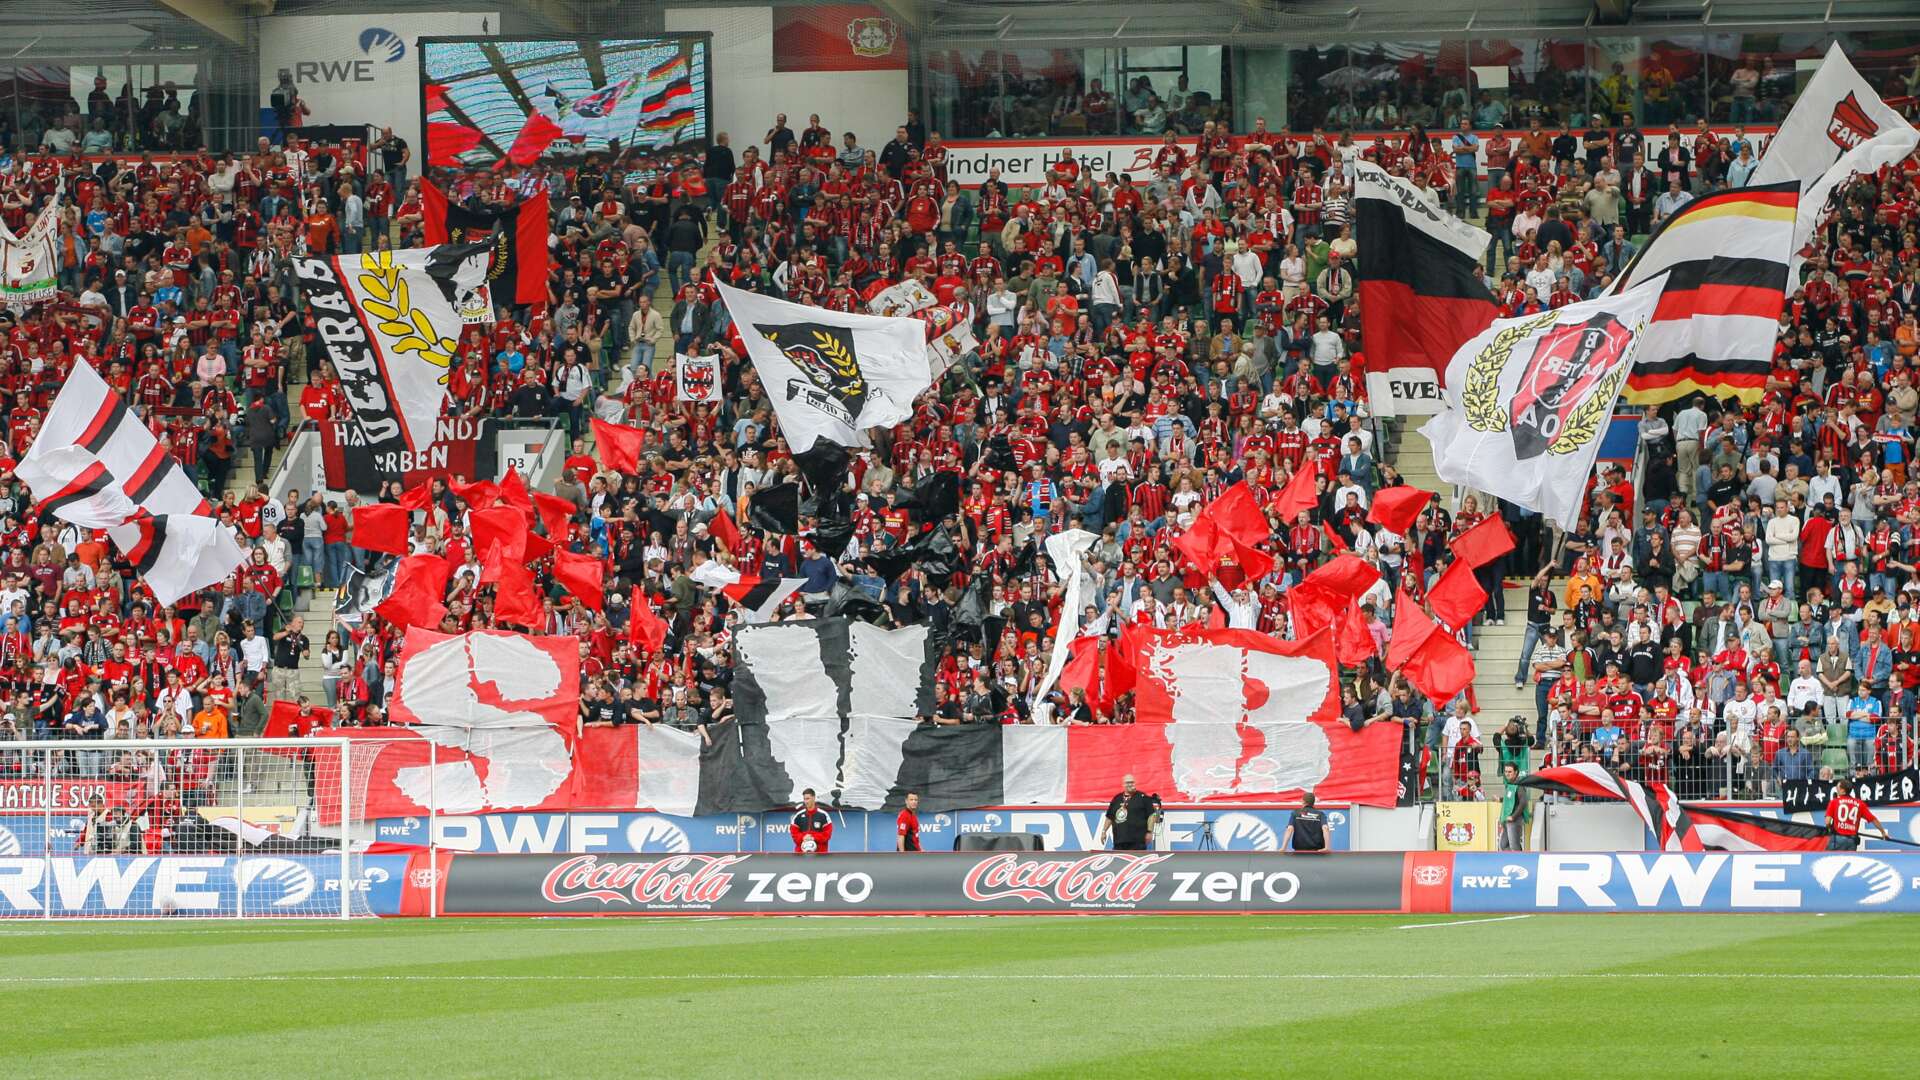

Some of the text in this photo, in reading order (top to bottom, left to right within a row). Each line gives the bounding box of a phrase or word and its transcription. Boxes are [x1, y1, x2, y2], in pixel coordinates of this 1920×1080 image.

[296, 60, 375, 83] RWE
[949, 152, 1033, 174] indner
[1043, 150, 1111, 173] Htel
[264, 508, 277, 518] 98
[1837, 803, 1859, 825] 04
[380, 826, 411, 836] RWE
[716, 825, 746, 835] RWE
[766, 824, 791, 834] RW
[919, 823, 941, 833] WE
[961, 823, 992, 833] RWE
[541, 853, 873, 905] Coca-Cola zero
[963, 853, 1300, 904] Coca-Cola zero
[1462, 875, 1512, 888] RWE
[1536, 854, 1802, 907] RWE
